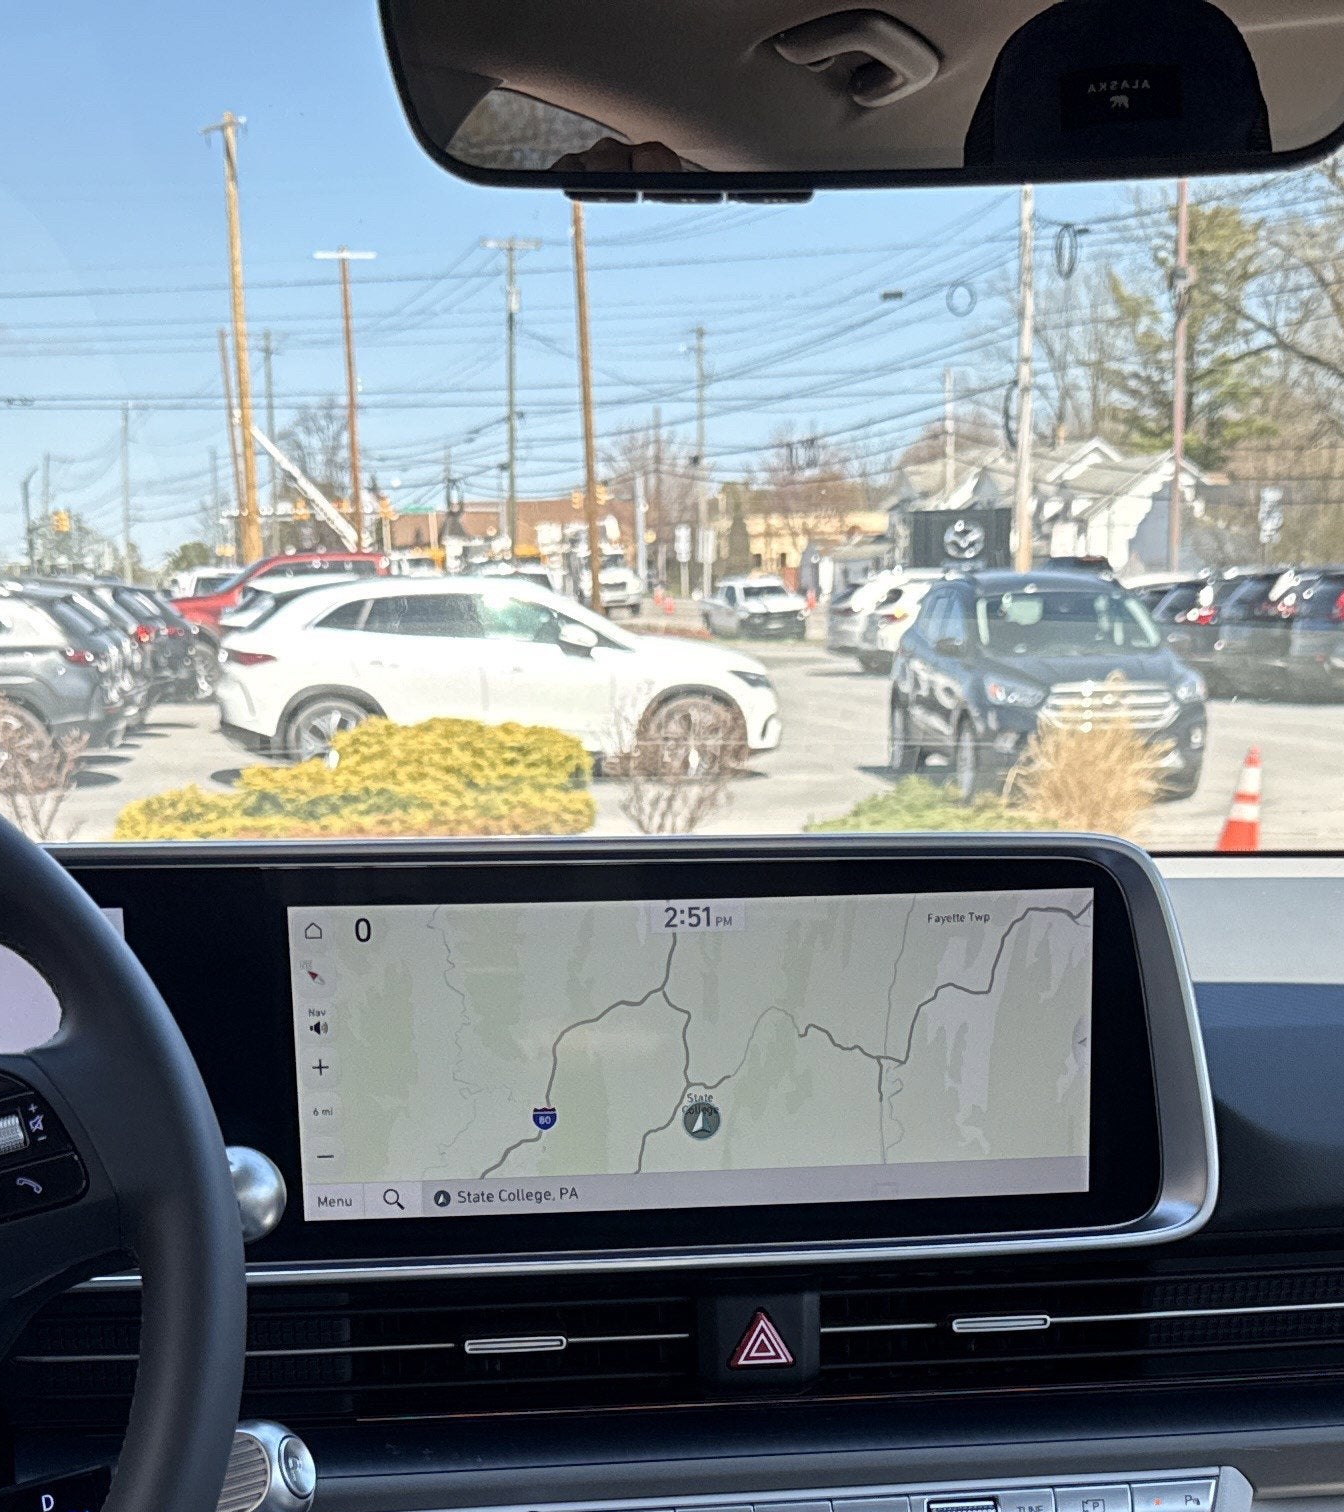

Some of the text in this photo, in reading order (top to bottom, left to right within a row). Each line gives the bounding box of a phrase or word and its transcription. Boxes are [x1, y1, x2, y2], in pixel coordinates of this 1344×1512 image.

[664, 906, 733, 928] 2:51 PM
[927, 912, 991, 924] Fayette Twp
[355, 918, 372, 942] 0
[687, 1093, 714, 1103] State
[321, 1107, 334, 1116] mi
[538, 1114, 552, 1126] 80
[317, 1197, 353, 1208] Menu
[457, 1187, 579, 1206] State College, PA
[41, 1494, 55, 1512] D
